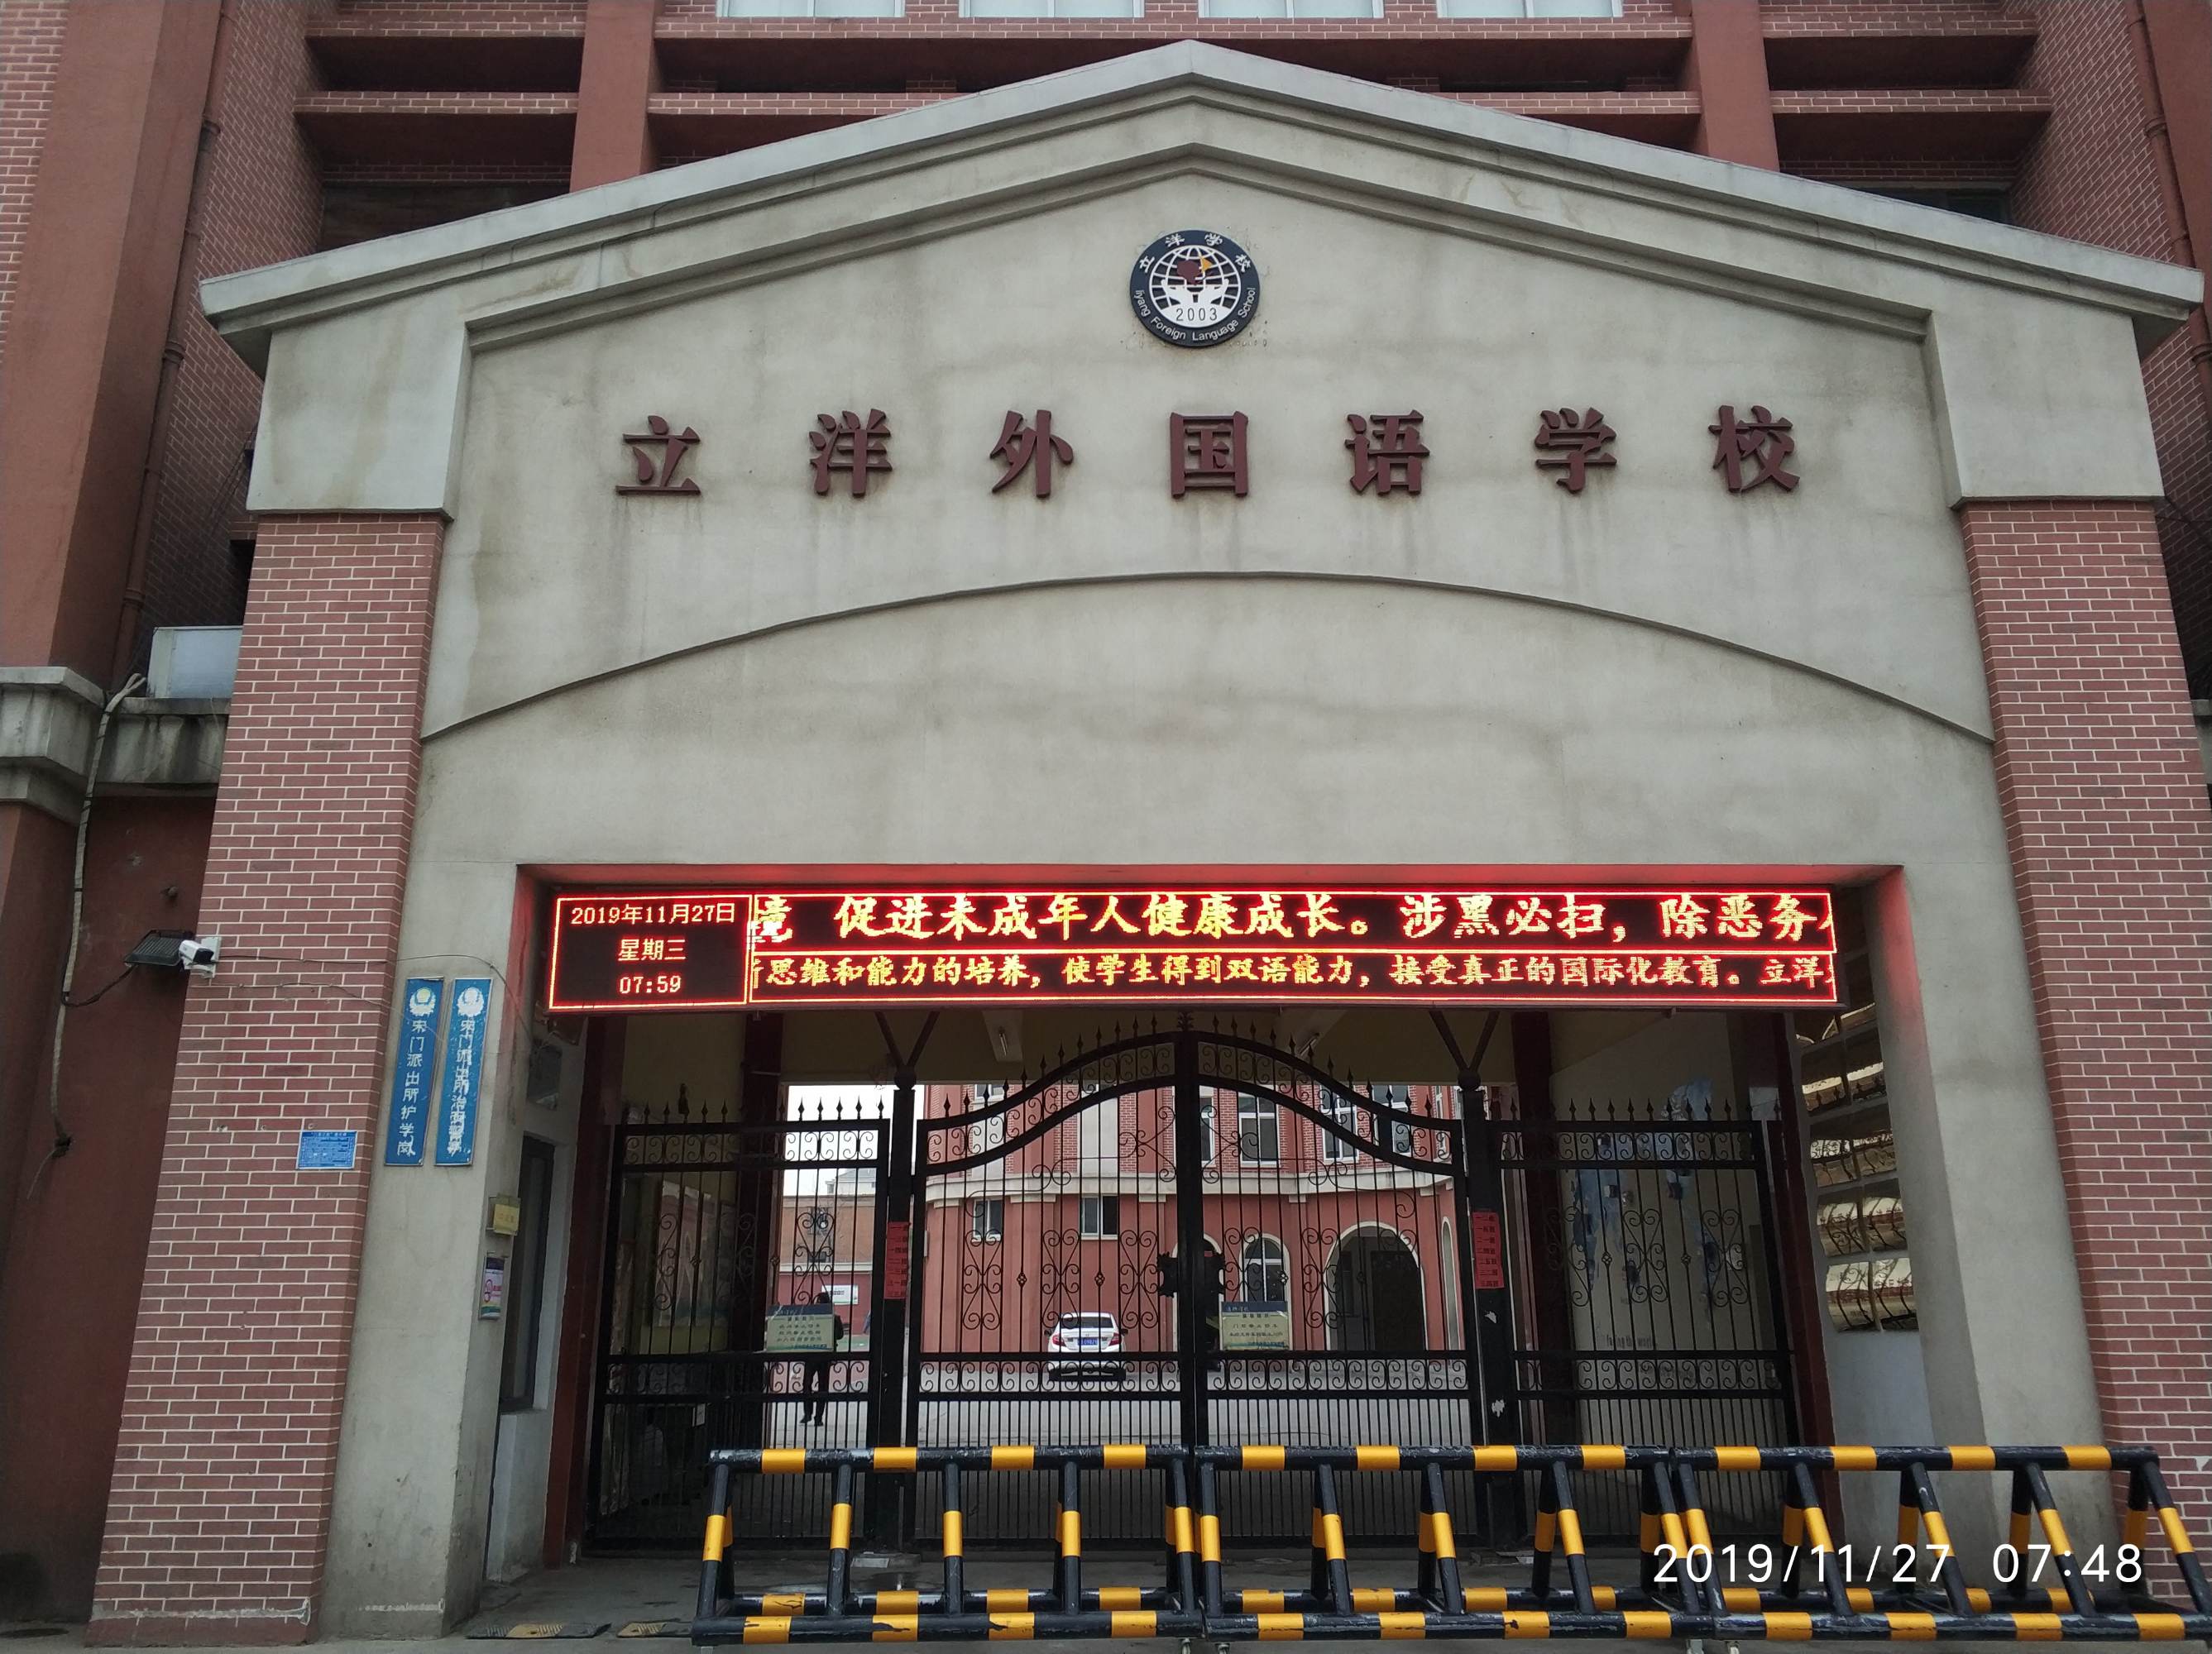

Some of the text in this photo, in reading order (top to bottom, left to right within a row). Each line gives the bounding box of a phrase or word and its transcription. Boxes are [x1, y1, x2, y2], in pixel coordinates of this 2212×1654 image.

[1151, 316, 1186, 340] Foreign
[1192, 319, 1239, 341] Language
[1238, 287, 1256, 318] School
[1175, 308, 1218, 321] 2003
[615, 403, 1800, 496] 立洋外国语学校
[571, 902, 735, 925] 2019年11月27日
[618, 939, 687, 961] 星期三
[620, 975, 682, 994] 07:59
